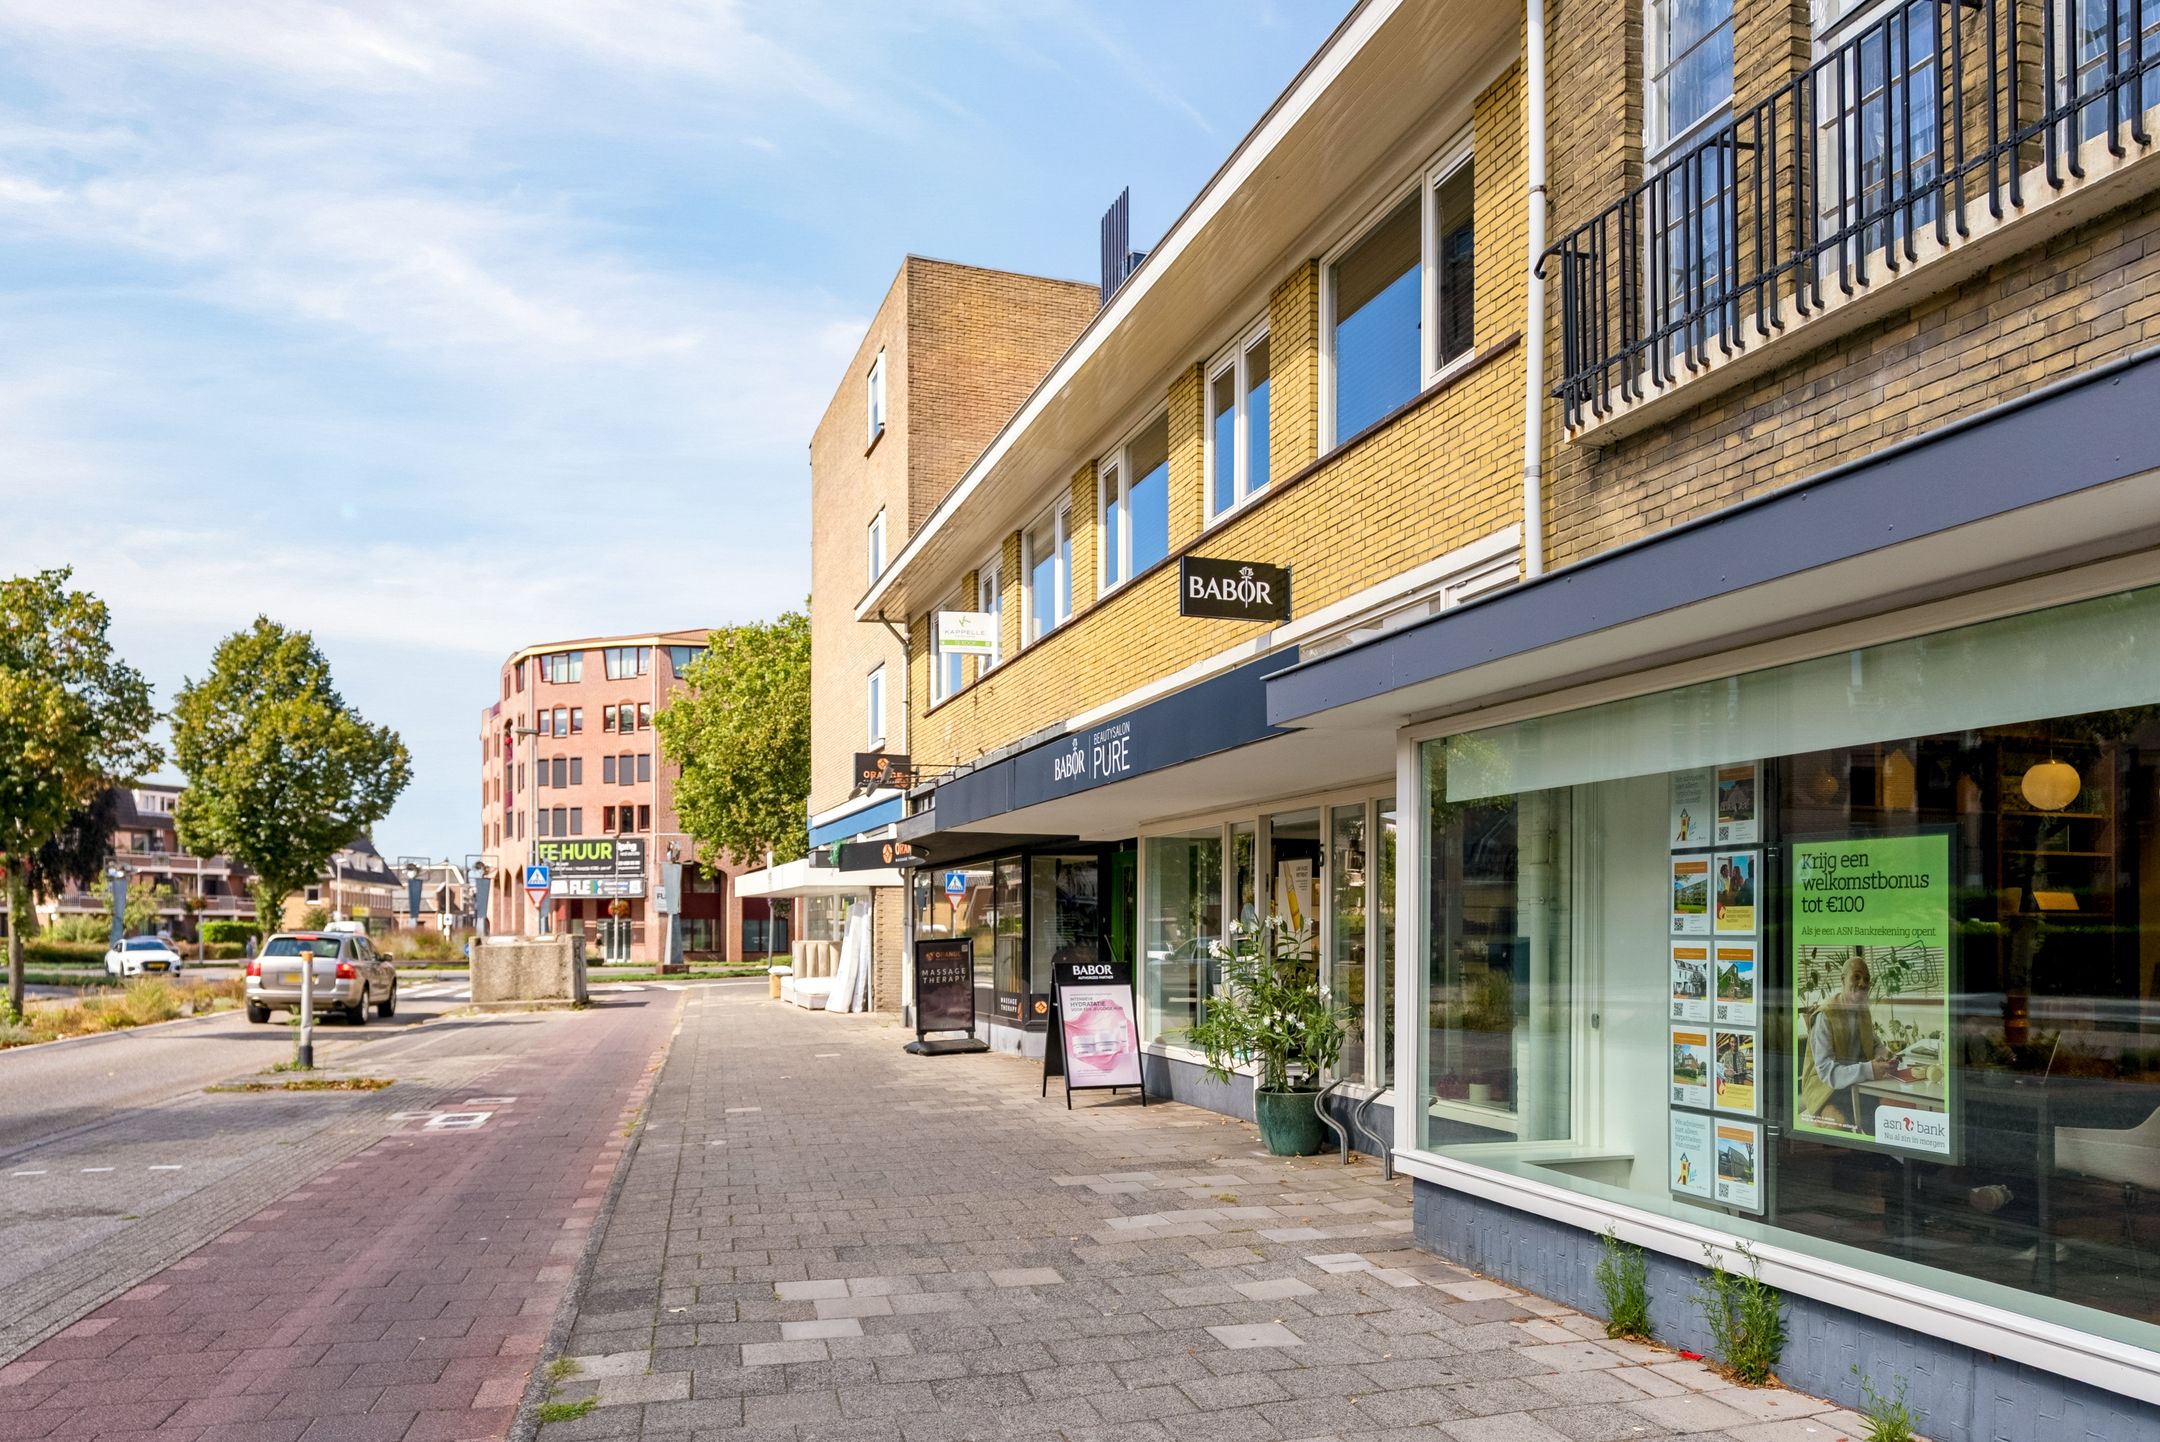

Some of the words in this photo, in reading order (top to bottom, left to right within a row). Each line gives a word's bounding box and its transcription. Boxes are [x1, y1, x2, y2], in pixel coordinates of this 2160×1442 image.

[1189, 573, 1273, 608] BABOR
[1093, 720, 1131, 746] BEAUTYSALON
[1054, 747, 1086, 781] BABOR
[1093, 735, 1131, 780] PURE
[539, 843, 559, 861] TE
[561, 842, 613, 860] HUUR
[1801, 852, 1837, 872] Krijg
[1840, 853, 1870, 868] een
[1802, 870, 1930, 891] welkomstbonus
[1801, 896, 1823, 913] tot
[1826, 895, 1865, 913] €100
[1801, 926, 1813, 936] Als
[1814, 927, 1821, 938] je
[1821, 928, 1836, 937] een
[1836, 927, 1854, 936] ASN
[1854, 926, 1911, 939] Bankrekening
[1911, 927, 1937, 939] opent
[921, 967, 966, 977] MASSAGE
[1072, 964, 1113, 976] BABOR
[922, 975, 966, 985] THERAPY
[1000, 1004, 1017, 1013] THERAPY
[1883, 1118, 1901, 1131] asn
[1917, 1120, 1946, 1137] bank
[1884, 1132, 1893, 1141] Nu
[1894, 1133, 1901, 1142] al
[1901, 1134, 1912, 1143] zin
[1912, 1135, 1919, 1144] in
[1919, 1137, 1946, 1149] morgen
